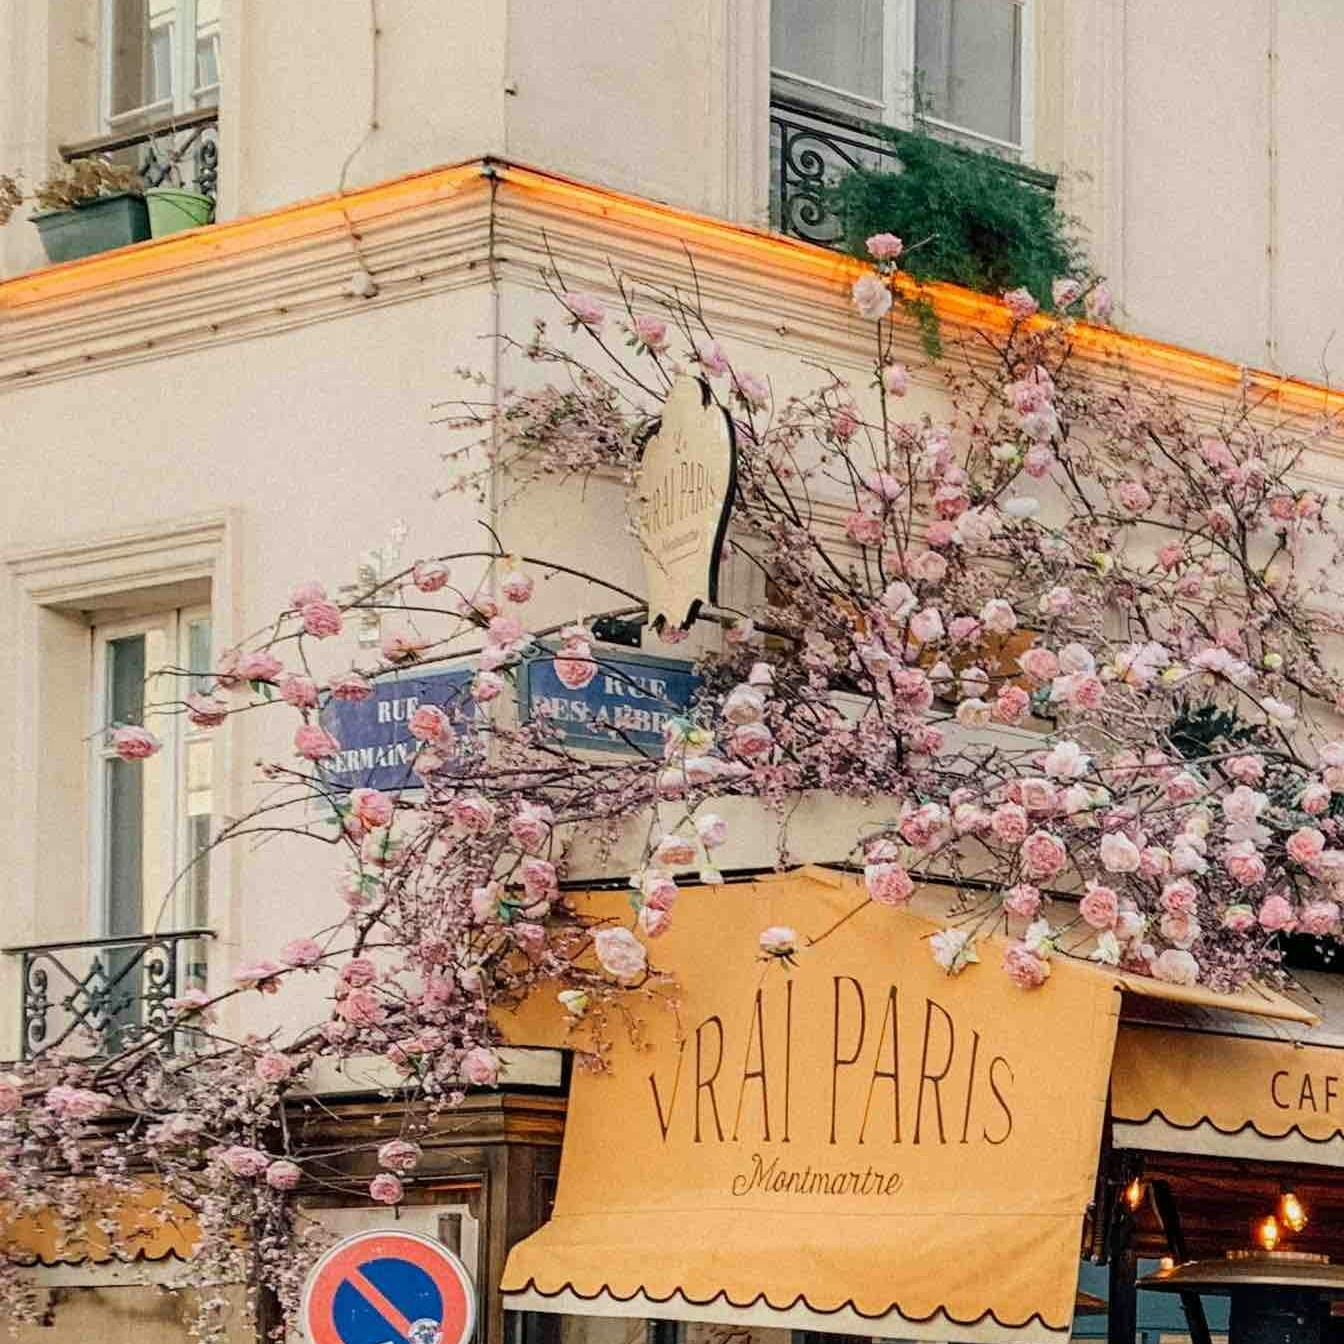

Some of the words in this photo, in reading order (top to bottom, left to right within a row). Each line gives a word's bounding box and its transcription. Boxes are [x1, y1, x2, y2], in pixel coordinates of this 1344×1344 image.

[604, 673, 668, 702] RUE
[378, 696, 418, 724] RUE
[648, 978, 793, 1144] VRAI
[826, 975, 1016, 1146] PARIS
[731, 1152, 903, 1197] Montmartre
